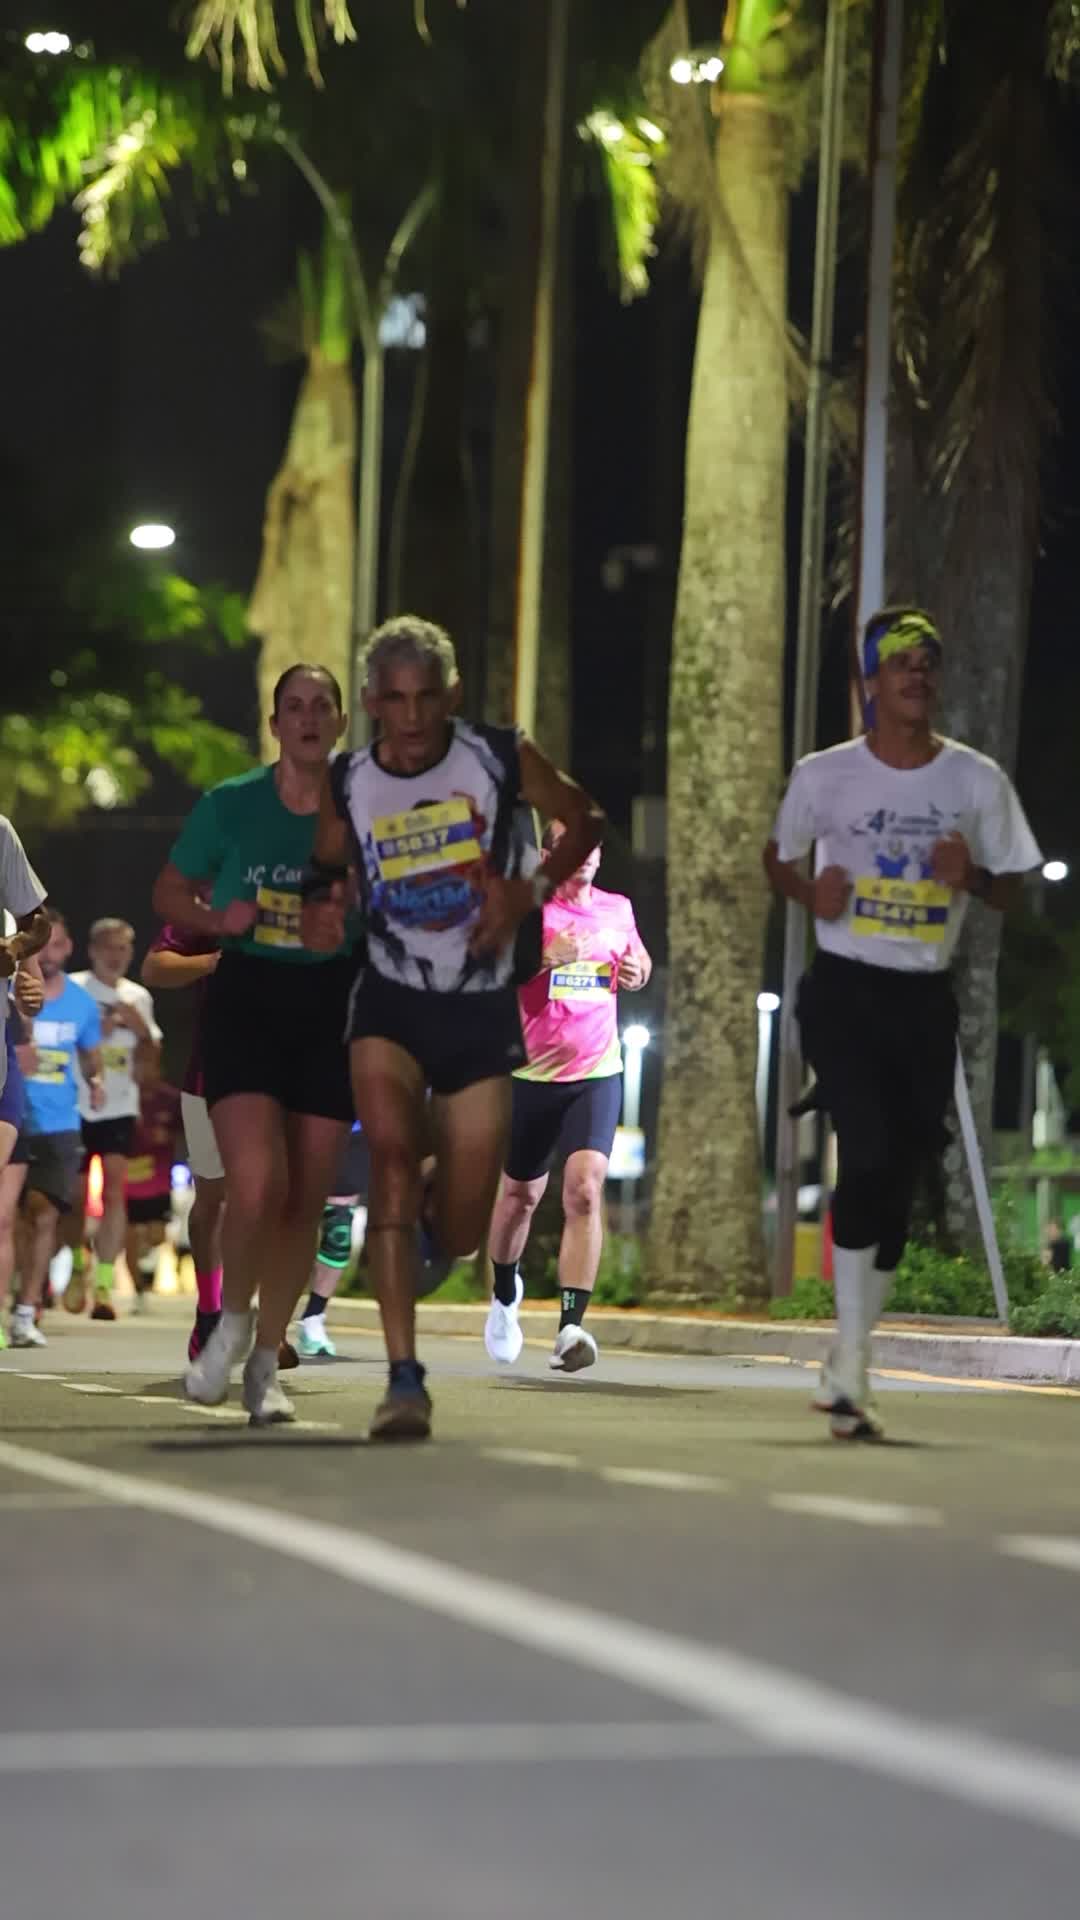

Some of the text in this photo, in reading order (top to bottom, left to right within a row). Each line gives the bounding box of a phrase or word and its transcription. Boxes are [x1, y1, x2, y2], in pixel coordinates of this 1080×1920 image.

[396, 828, 449, 853] 5837
[243, 865, 266, 884] JC
[565, 975, 597, 988] 6271
